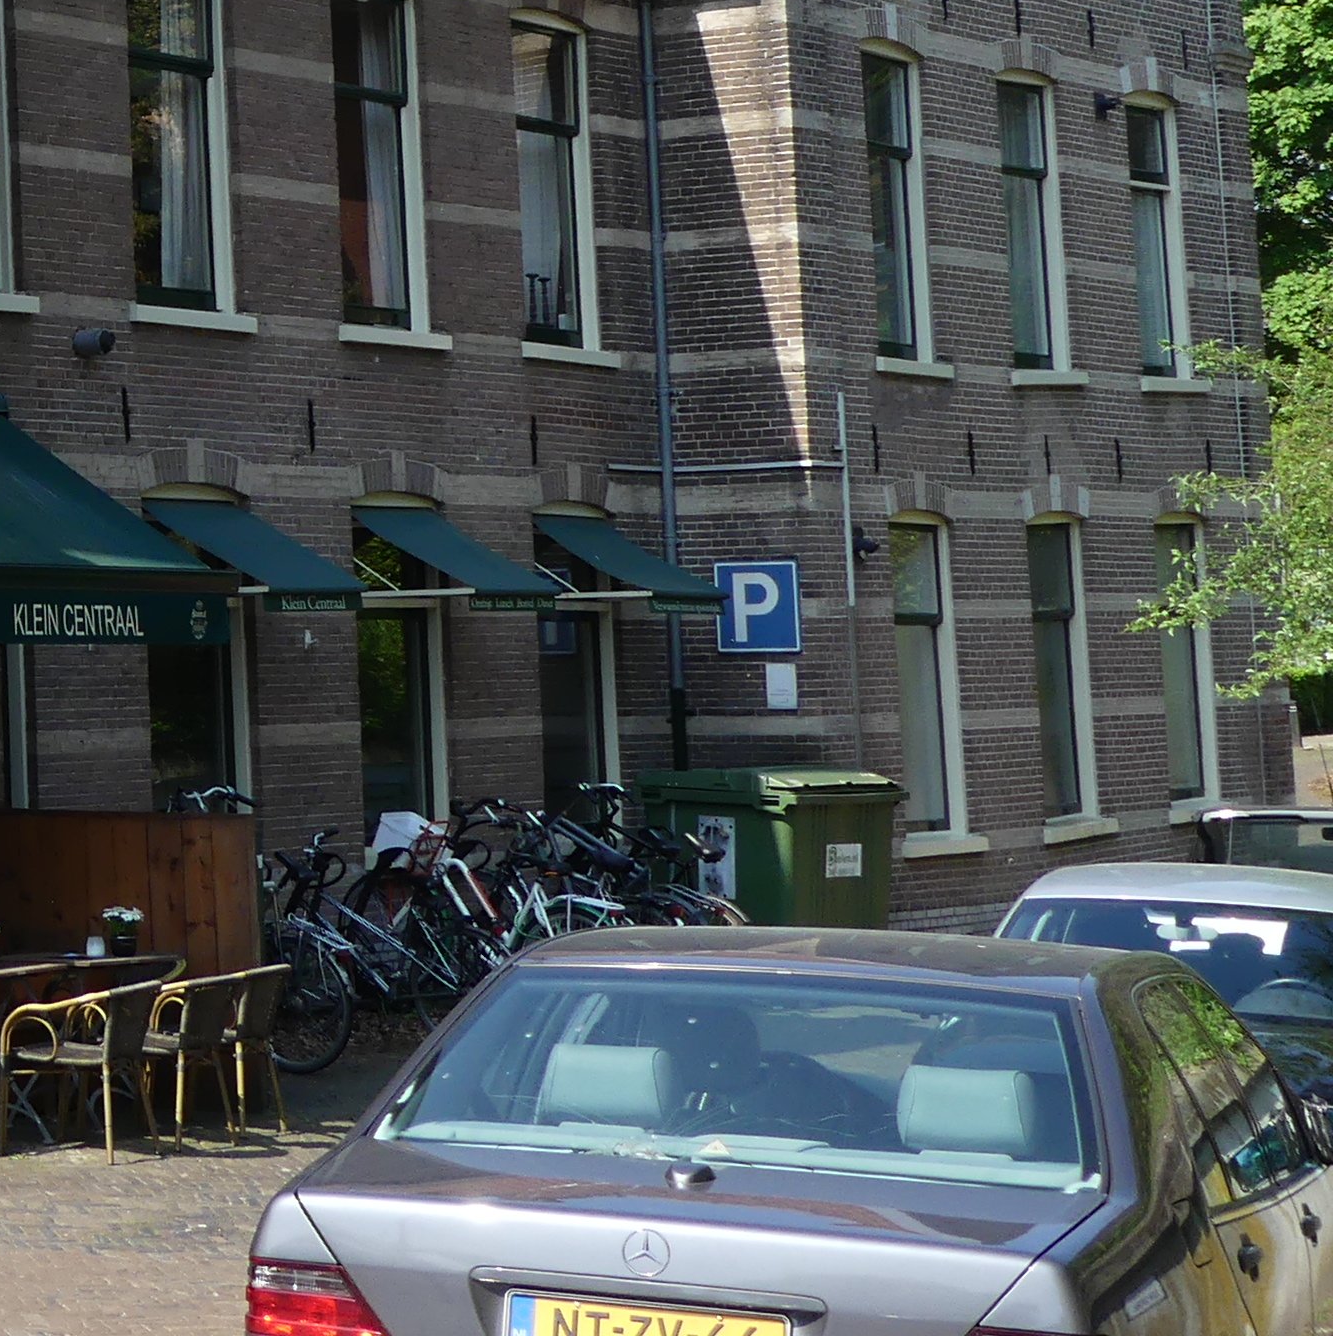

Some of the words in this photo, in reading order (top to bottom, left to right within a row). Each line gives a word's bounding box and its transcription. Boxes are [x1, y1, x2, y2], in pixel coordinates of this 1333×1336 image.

[281, 594, 307, 610] Klein
[307, 594, 346, 610] Centraal
[732, 572, 779, 643] P
[13, 603, 60, 636] KLEIN
[62, 603, 144, 637] CENTRAAL
[553, 1307, 757, 1336] NT-Z
